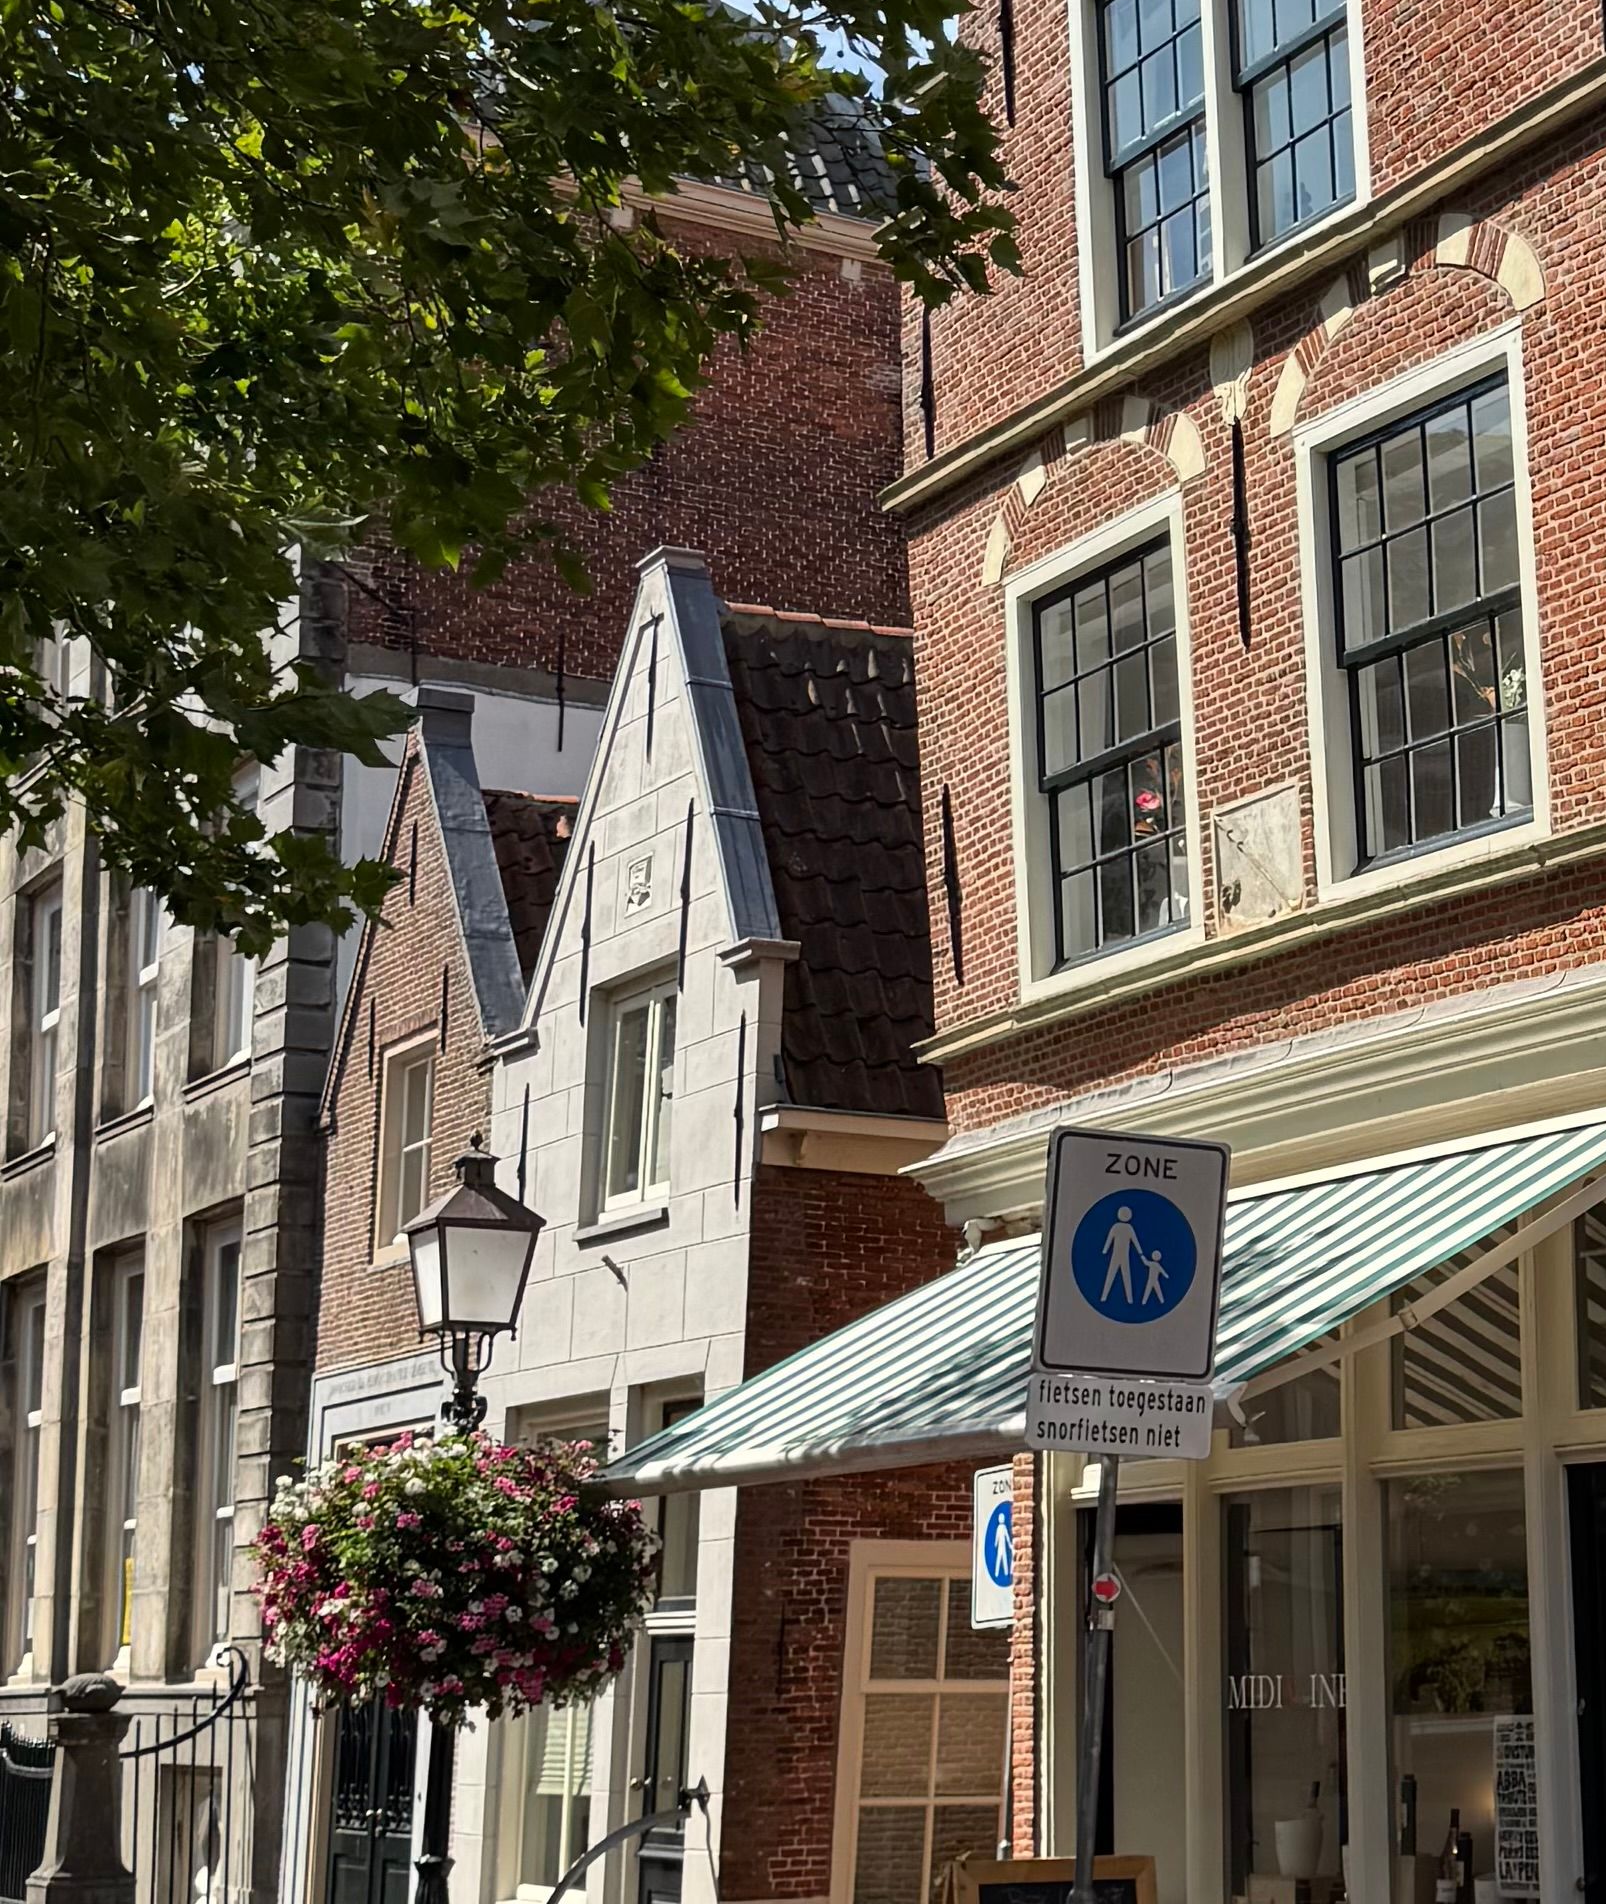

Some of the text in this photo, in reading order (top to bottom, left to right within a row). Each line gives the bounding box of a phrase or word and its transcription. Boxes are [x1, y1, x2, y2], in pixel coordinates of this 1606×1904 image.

[1105, 1153, 1178, 1180] ZONE
[1039, 1379, 1206, 1416] fietsen toegestaan
[1037, 1418, 1181, 1447] snorfietsen niet
